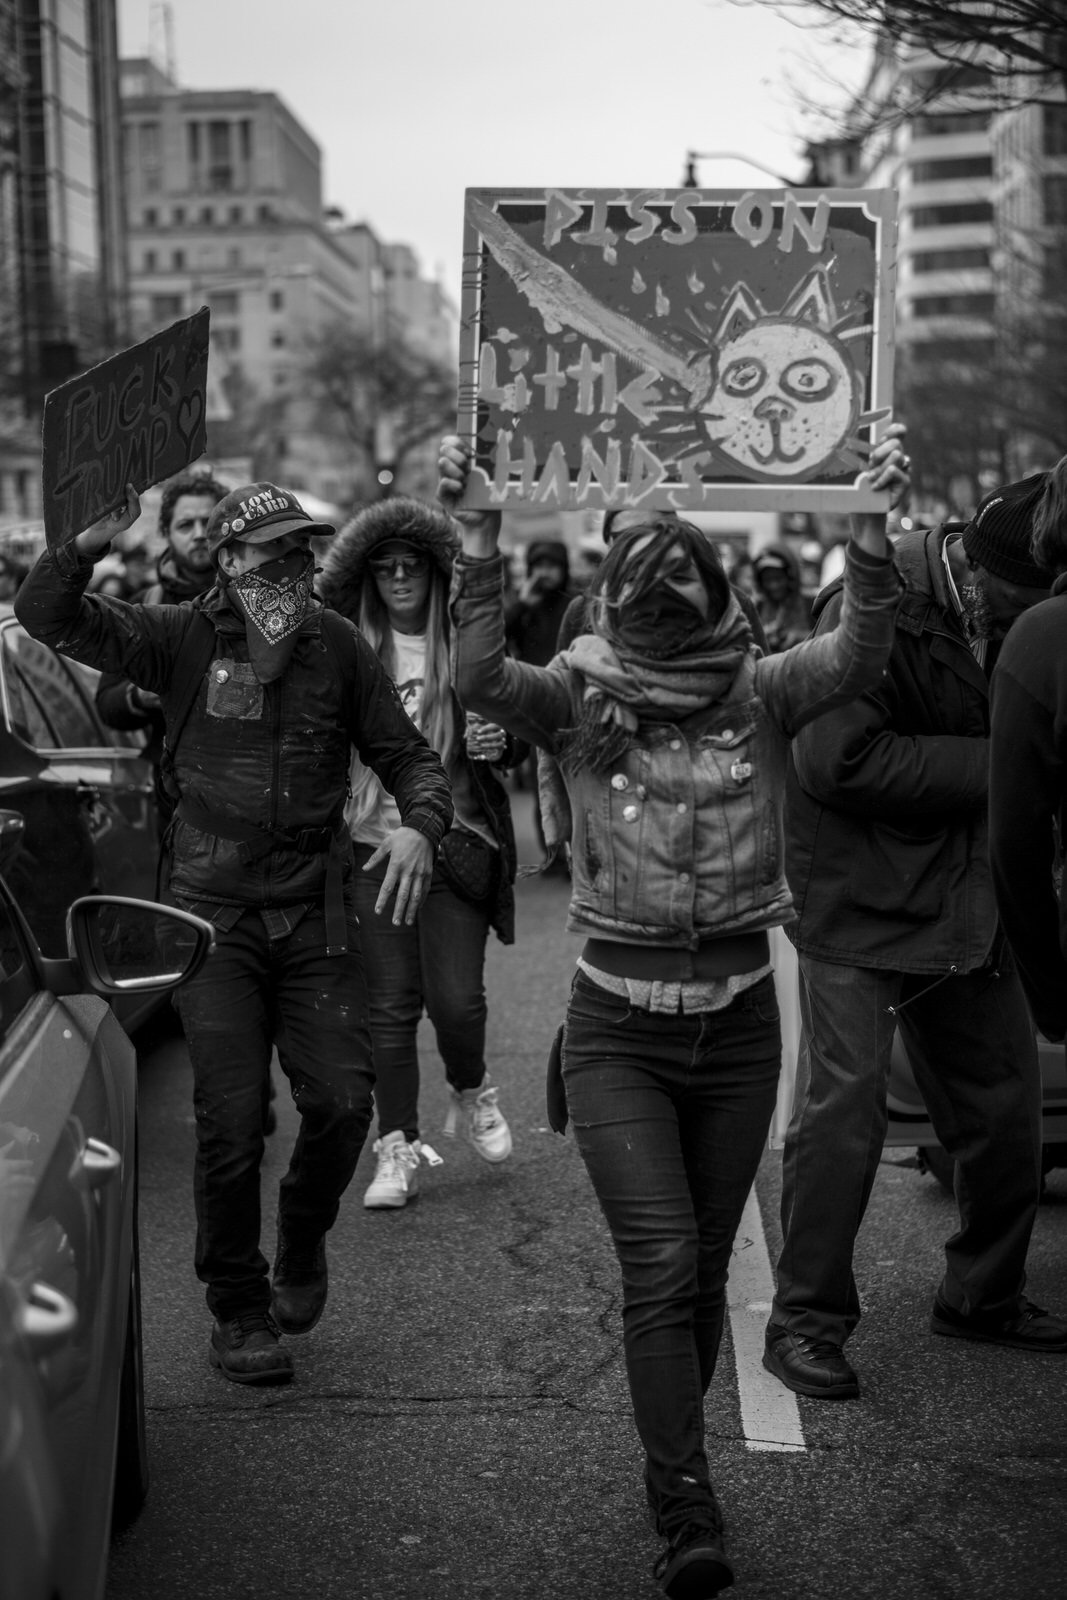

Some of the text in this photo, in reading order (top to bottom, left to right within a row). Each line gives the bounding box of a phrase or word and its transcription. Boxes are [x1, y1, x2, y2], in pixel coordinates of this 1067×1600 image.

[543, 188, 832, 253] PISS ON
[65, 344, 181, 468] FUCK
[53, 411, 171, 539] TRUMP
[239, 489, 273, 513] LOW
[489, 429, 712, 506] HANDS
[245, 497, 289, 520] CARD
